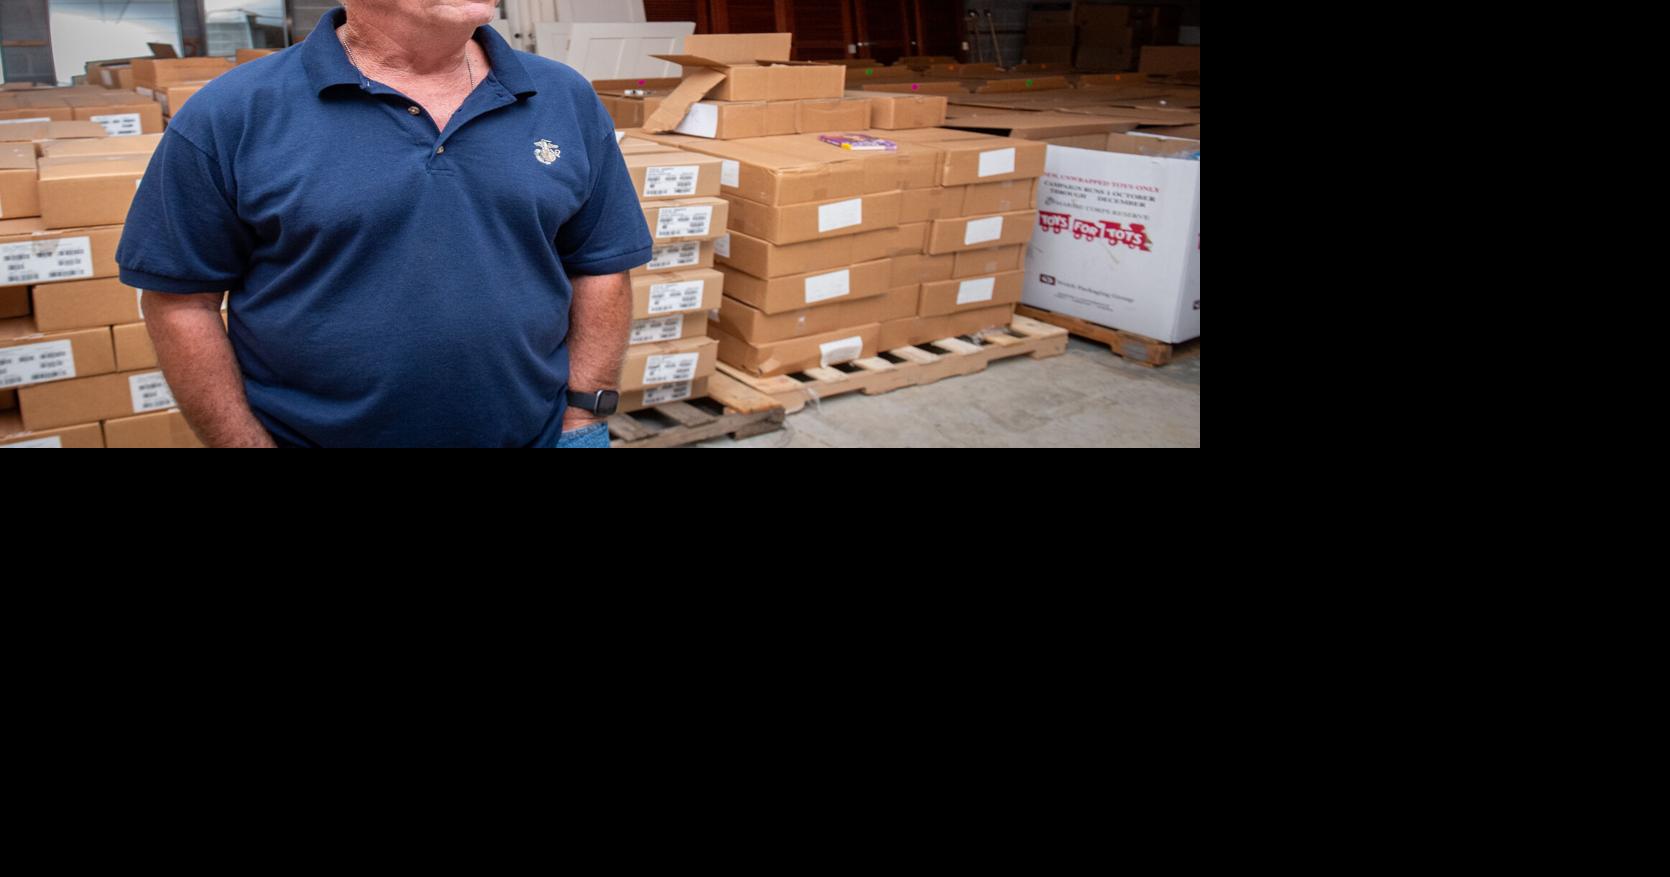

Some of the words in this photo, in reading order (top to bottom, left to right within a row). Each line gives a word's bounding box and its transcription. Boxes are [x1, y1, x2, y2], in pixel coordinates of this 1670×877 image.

[1097, 196, 1146, 208] DECEMBER
[1112, 191, 1155, 202] OCTOBER
[1040, 214, 1069, 229] TOYS
[1074, 220, 1099, 236] FOR
[1106, 228, 1143, 245] TOTS
